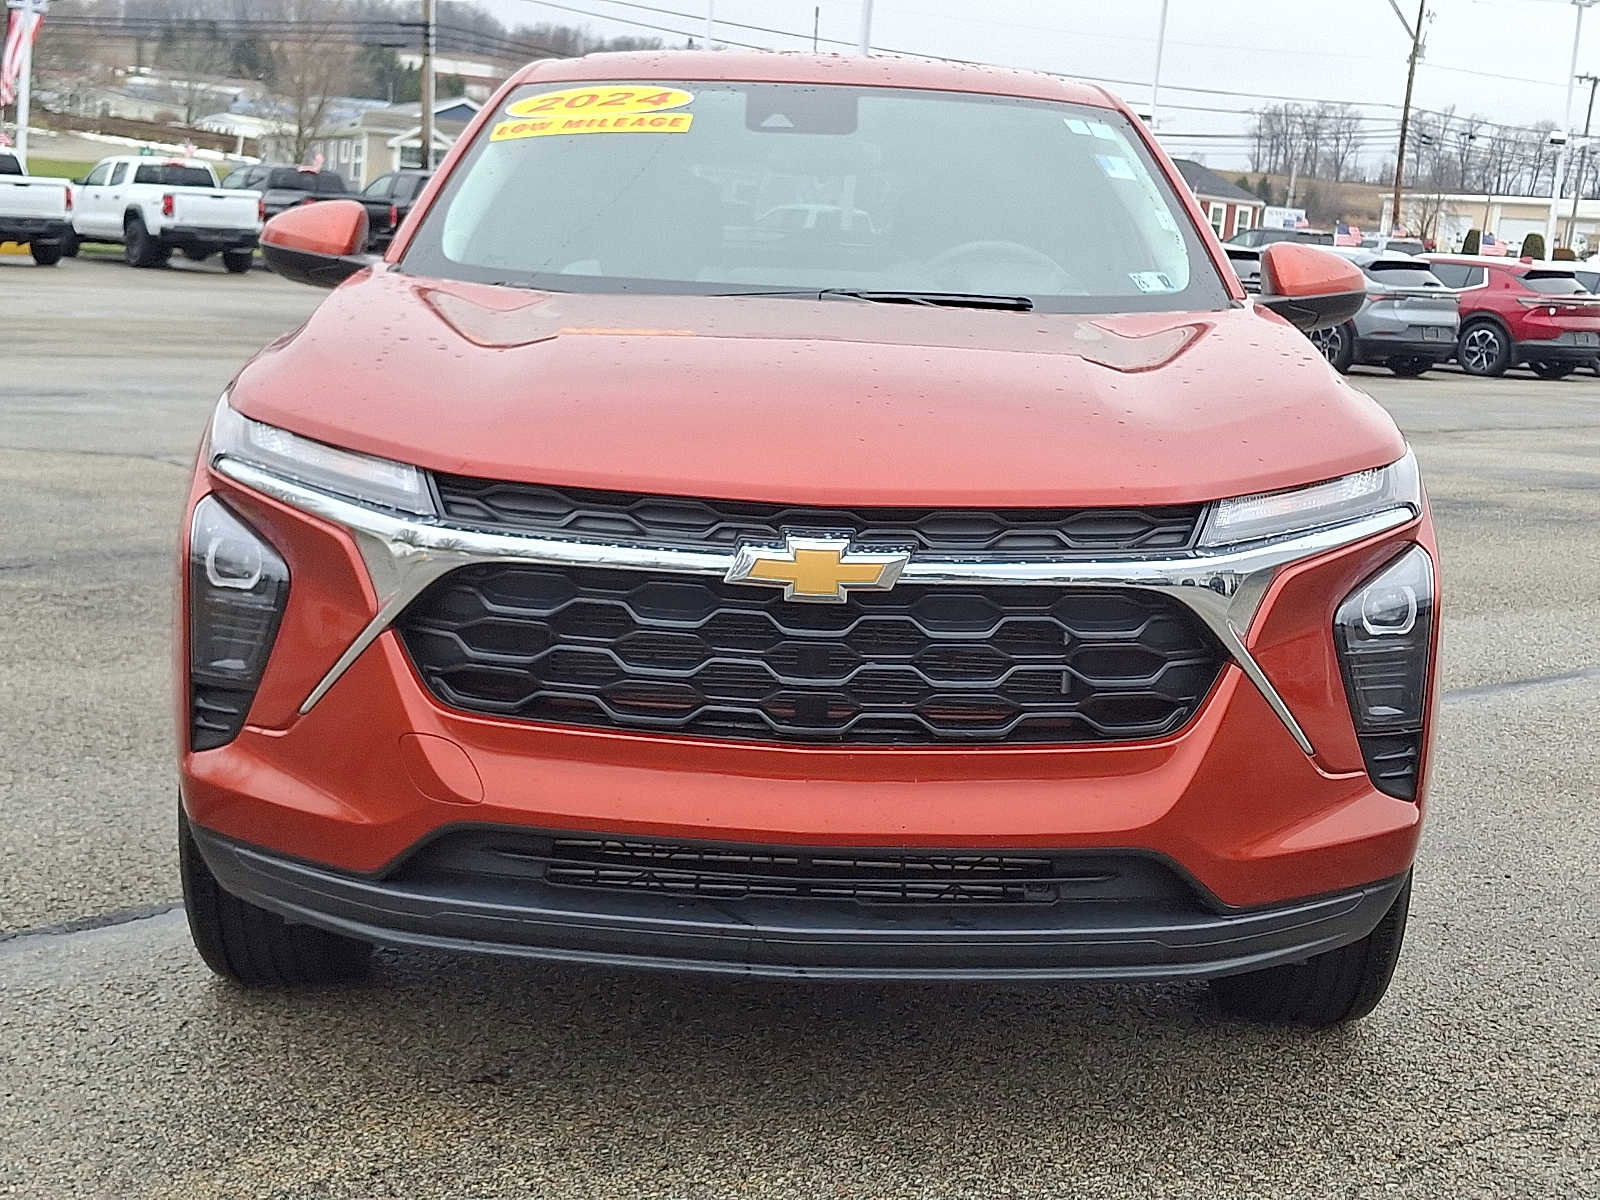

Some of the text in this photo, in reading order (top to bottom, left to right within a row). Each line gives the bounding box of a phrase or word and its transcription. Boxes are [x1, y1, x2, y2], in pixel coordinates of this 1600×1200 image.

[527, 91, 673, 114] 2024
[496, 117, 686, 136] LOW MILEAGE
